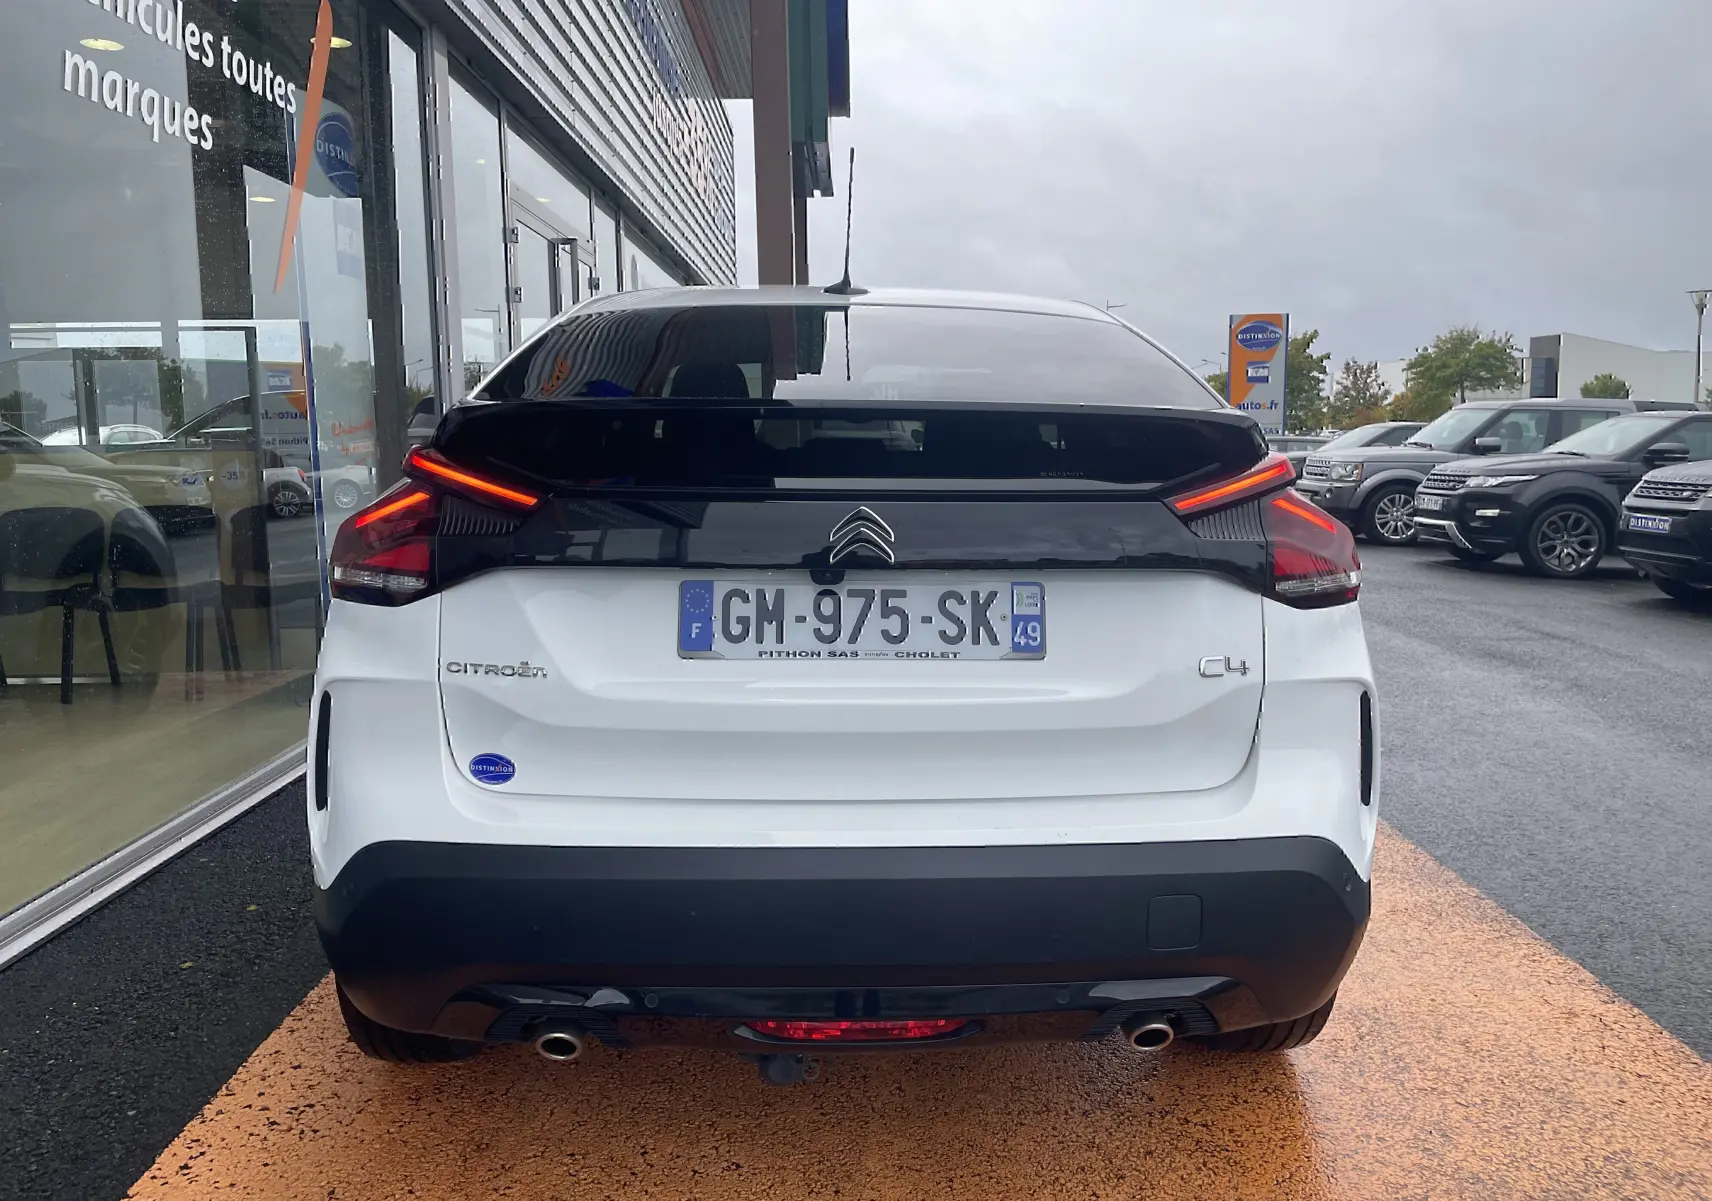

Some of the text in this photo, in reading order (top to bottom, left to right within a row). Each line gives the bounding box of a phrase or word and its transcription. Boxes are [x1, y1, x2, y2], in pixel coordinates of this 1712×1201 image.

[221, 36, 297, 114] toutes
[64, 50, 213, 150] marques
[1238, 332, 1280, 340] DISTINXION
[1237, 400, 1280, 410] autos.fr
[1263, 427, 1280, 435] SAS
[691, 588, 1040, 647] F GM-975-SK 49
[758, 650, 822, 658] PITHON
[827, 650, 860, 658] SAS
[894, 650, 961, 659] CHOLET
[1198, 655, 1250, 678] C4
[470, 763, 514, 774] DISTINXION
